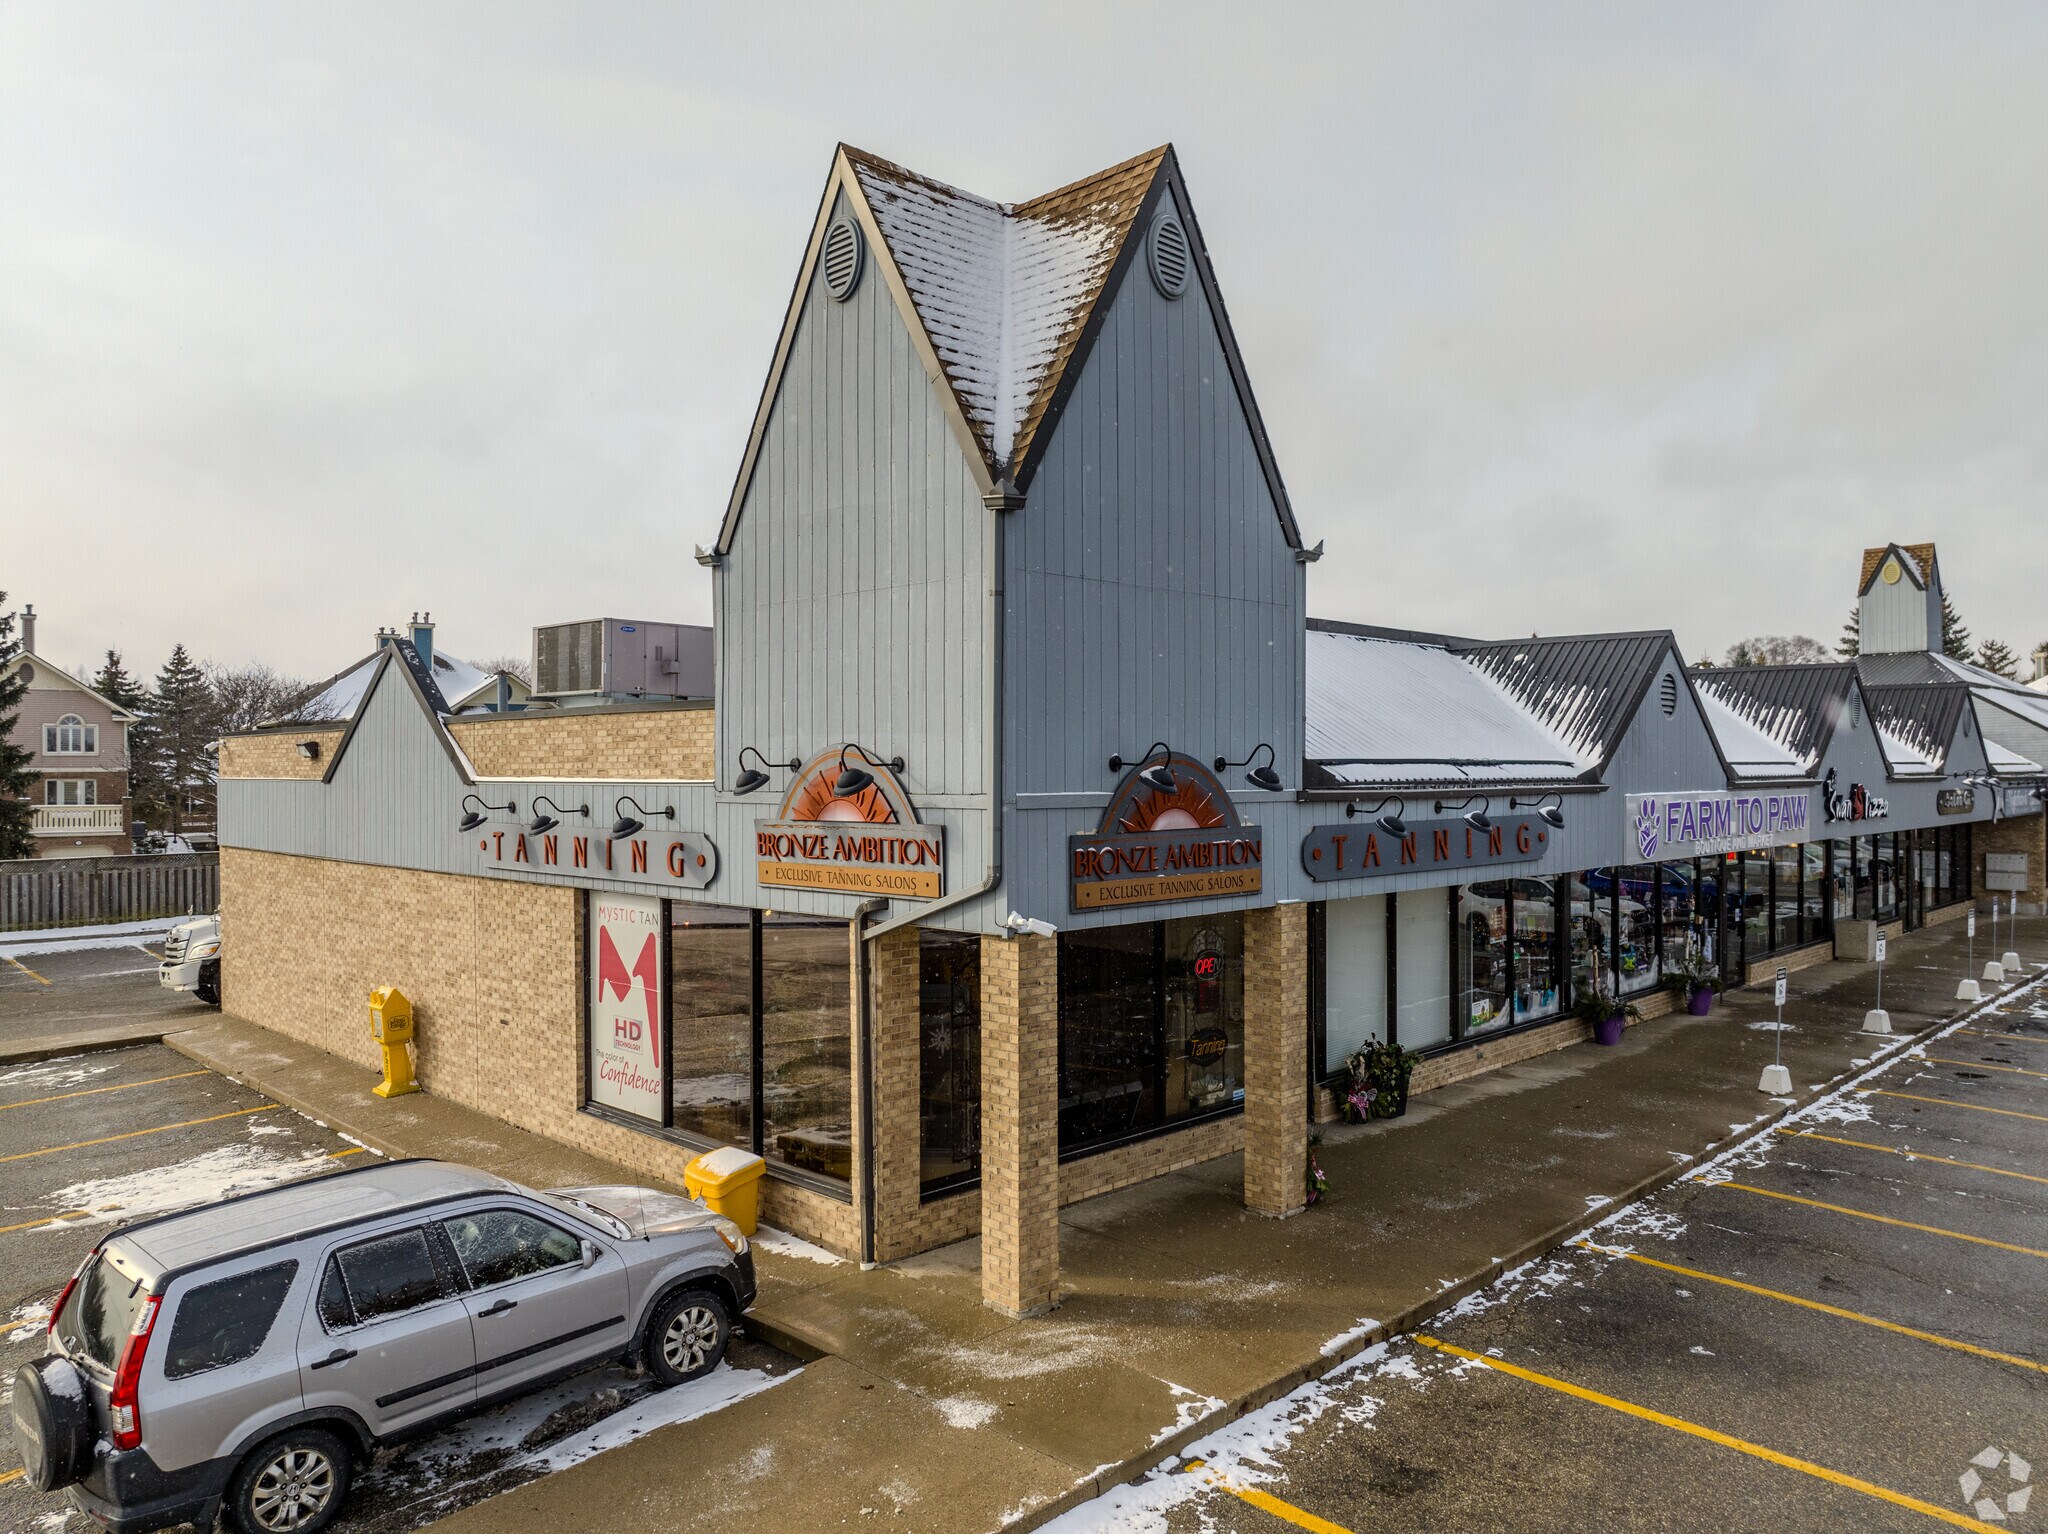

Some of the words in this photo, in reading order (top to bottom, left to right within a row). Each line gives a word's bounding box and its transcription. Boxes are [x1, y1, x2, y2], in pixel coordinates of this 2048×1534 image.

[1665, 799, 1732, 844] FARM
[1735, 797, 1763, 835] TO
[1765, 794, 1809, 833] PAW
[493, 831, 684, 877] TANNING
[756, 832, 829, 861] BRONZE
[833, 834, 940, 866] AMBITION
[1332, 822, 1531, 870] TANNING
[1695, 837, 1731, 855] BOUTIQUE
[1731, 836, 1747, 850] AND
[1748, 833, 1774, 847] MARKET
[1075, 845, 1160, 881] BRONZE
[1163, 839, 1262, 870] AMBITION
[775, 867, 823, 883] EXCLUSIVE
[826, 871, 872, 887] TANNING
[875, 875, 917, 890] SALONS
[1100, 884, 1155, 900] EXCLUSIVE
[1159, 879, 1204, 895] TANNING
[1208, 875, 1244, 890] SALONS
[598, 905, 636, 924] MYSTIC
[639, 911, 659, 926] TAN
[1195, 957, 1221, 975] OPEN
[615, 1018, 642, 1041] HD
[615, 1039, 641, 1052] TECHNOLOGY
[1190, 1037, 1226, 1057] Tanning
[600, 1060, 660, 1095] Confidence
